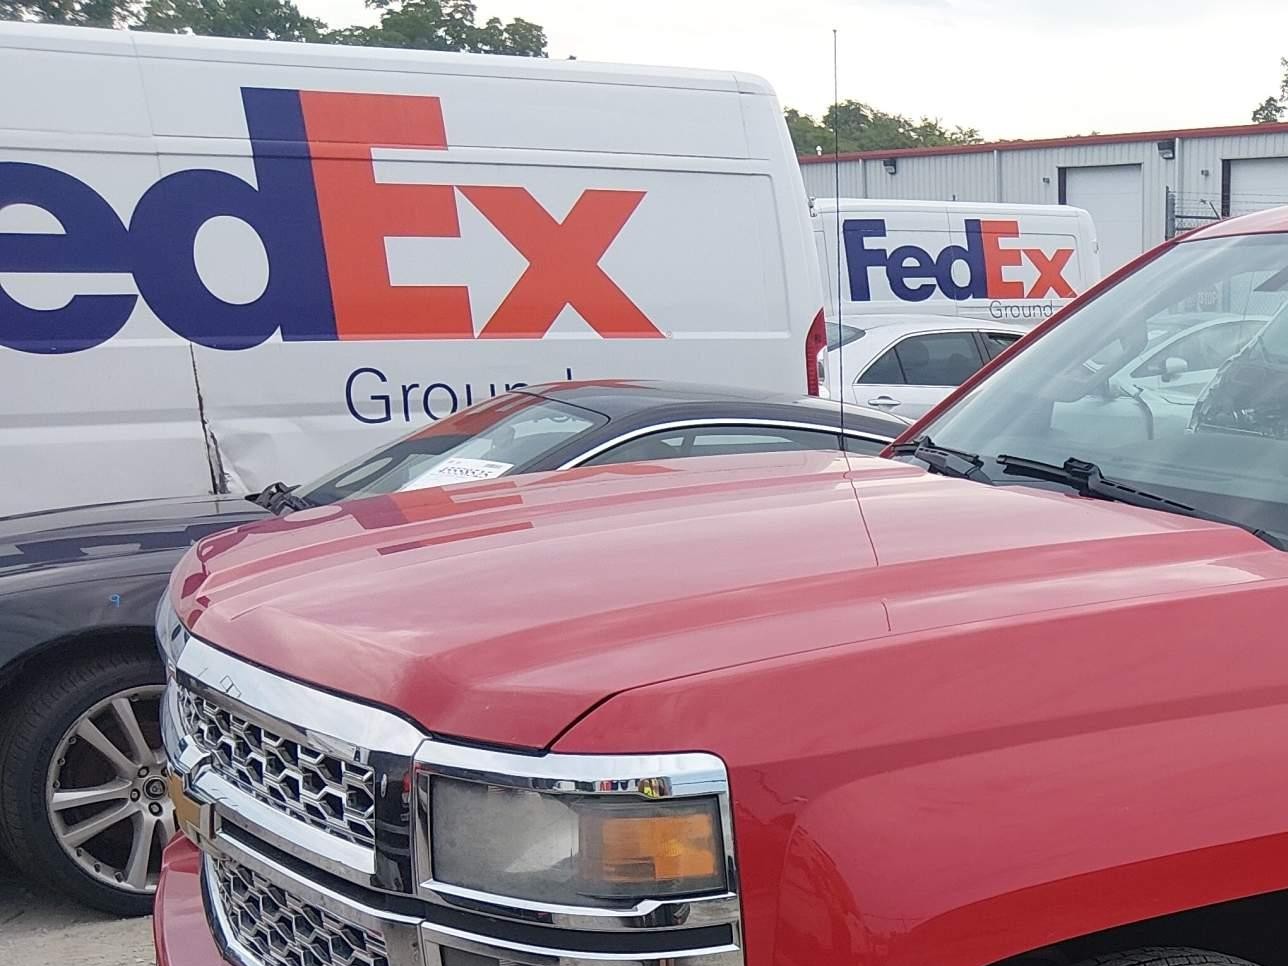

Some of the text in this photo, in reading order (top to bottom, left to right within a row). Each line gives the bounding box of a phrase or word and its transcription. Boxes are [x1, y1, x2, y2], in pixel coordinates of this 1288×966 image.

[843, 218, 1078, 302] FedEx
[989, 300, 1053, 319] Ground
[345, 367, 572, 424] Gro
